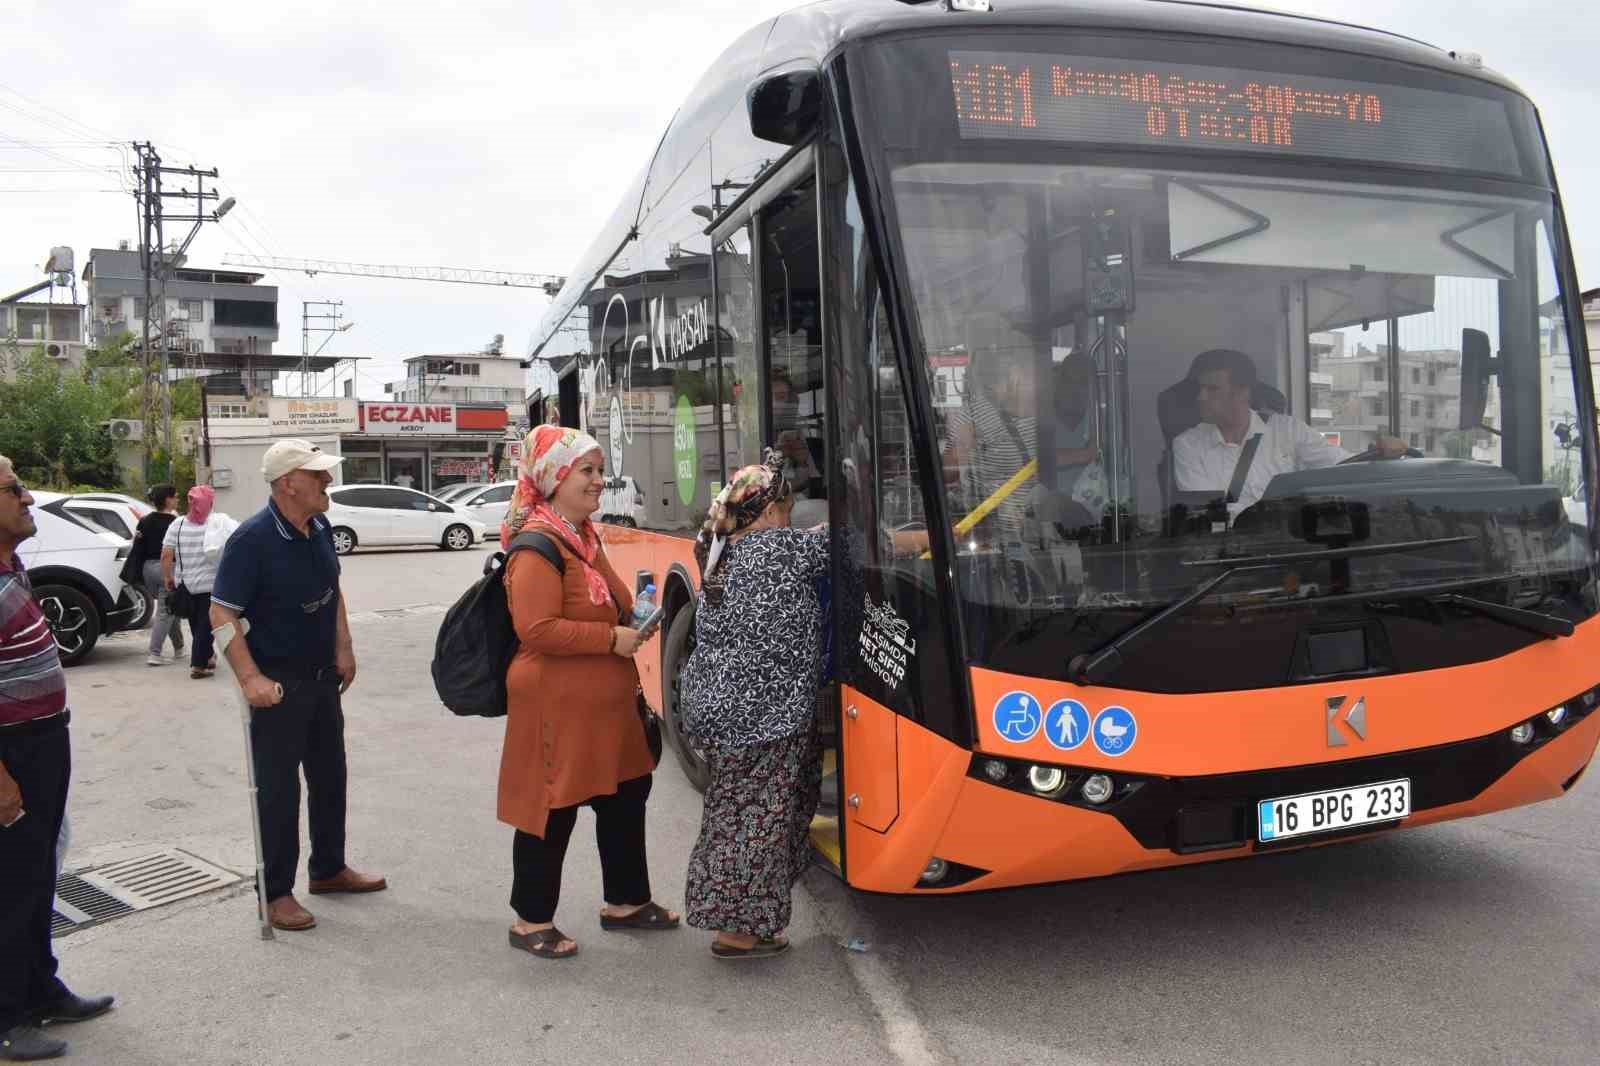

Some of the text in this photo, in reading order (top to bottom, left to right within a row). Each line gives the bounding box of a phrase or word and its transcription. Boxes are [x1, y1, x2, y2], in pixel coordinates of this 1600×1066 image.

[670, 297, 708, 360] KARSAN
[367, 406, 453, 423] ECZANE
[859, 631, 905, 681] NET SIFIR
[1275, 802, 1298, 833] 16
[1312, 794, 1353, 827] BPG
[1366, 785, 1406, 819] 233
